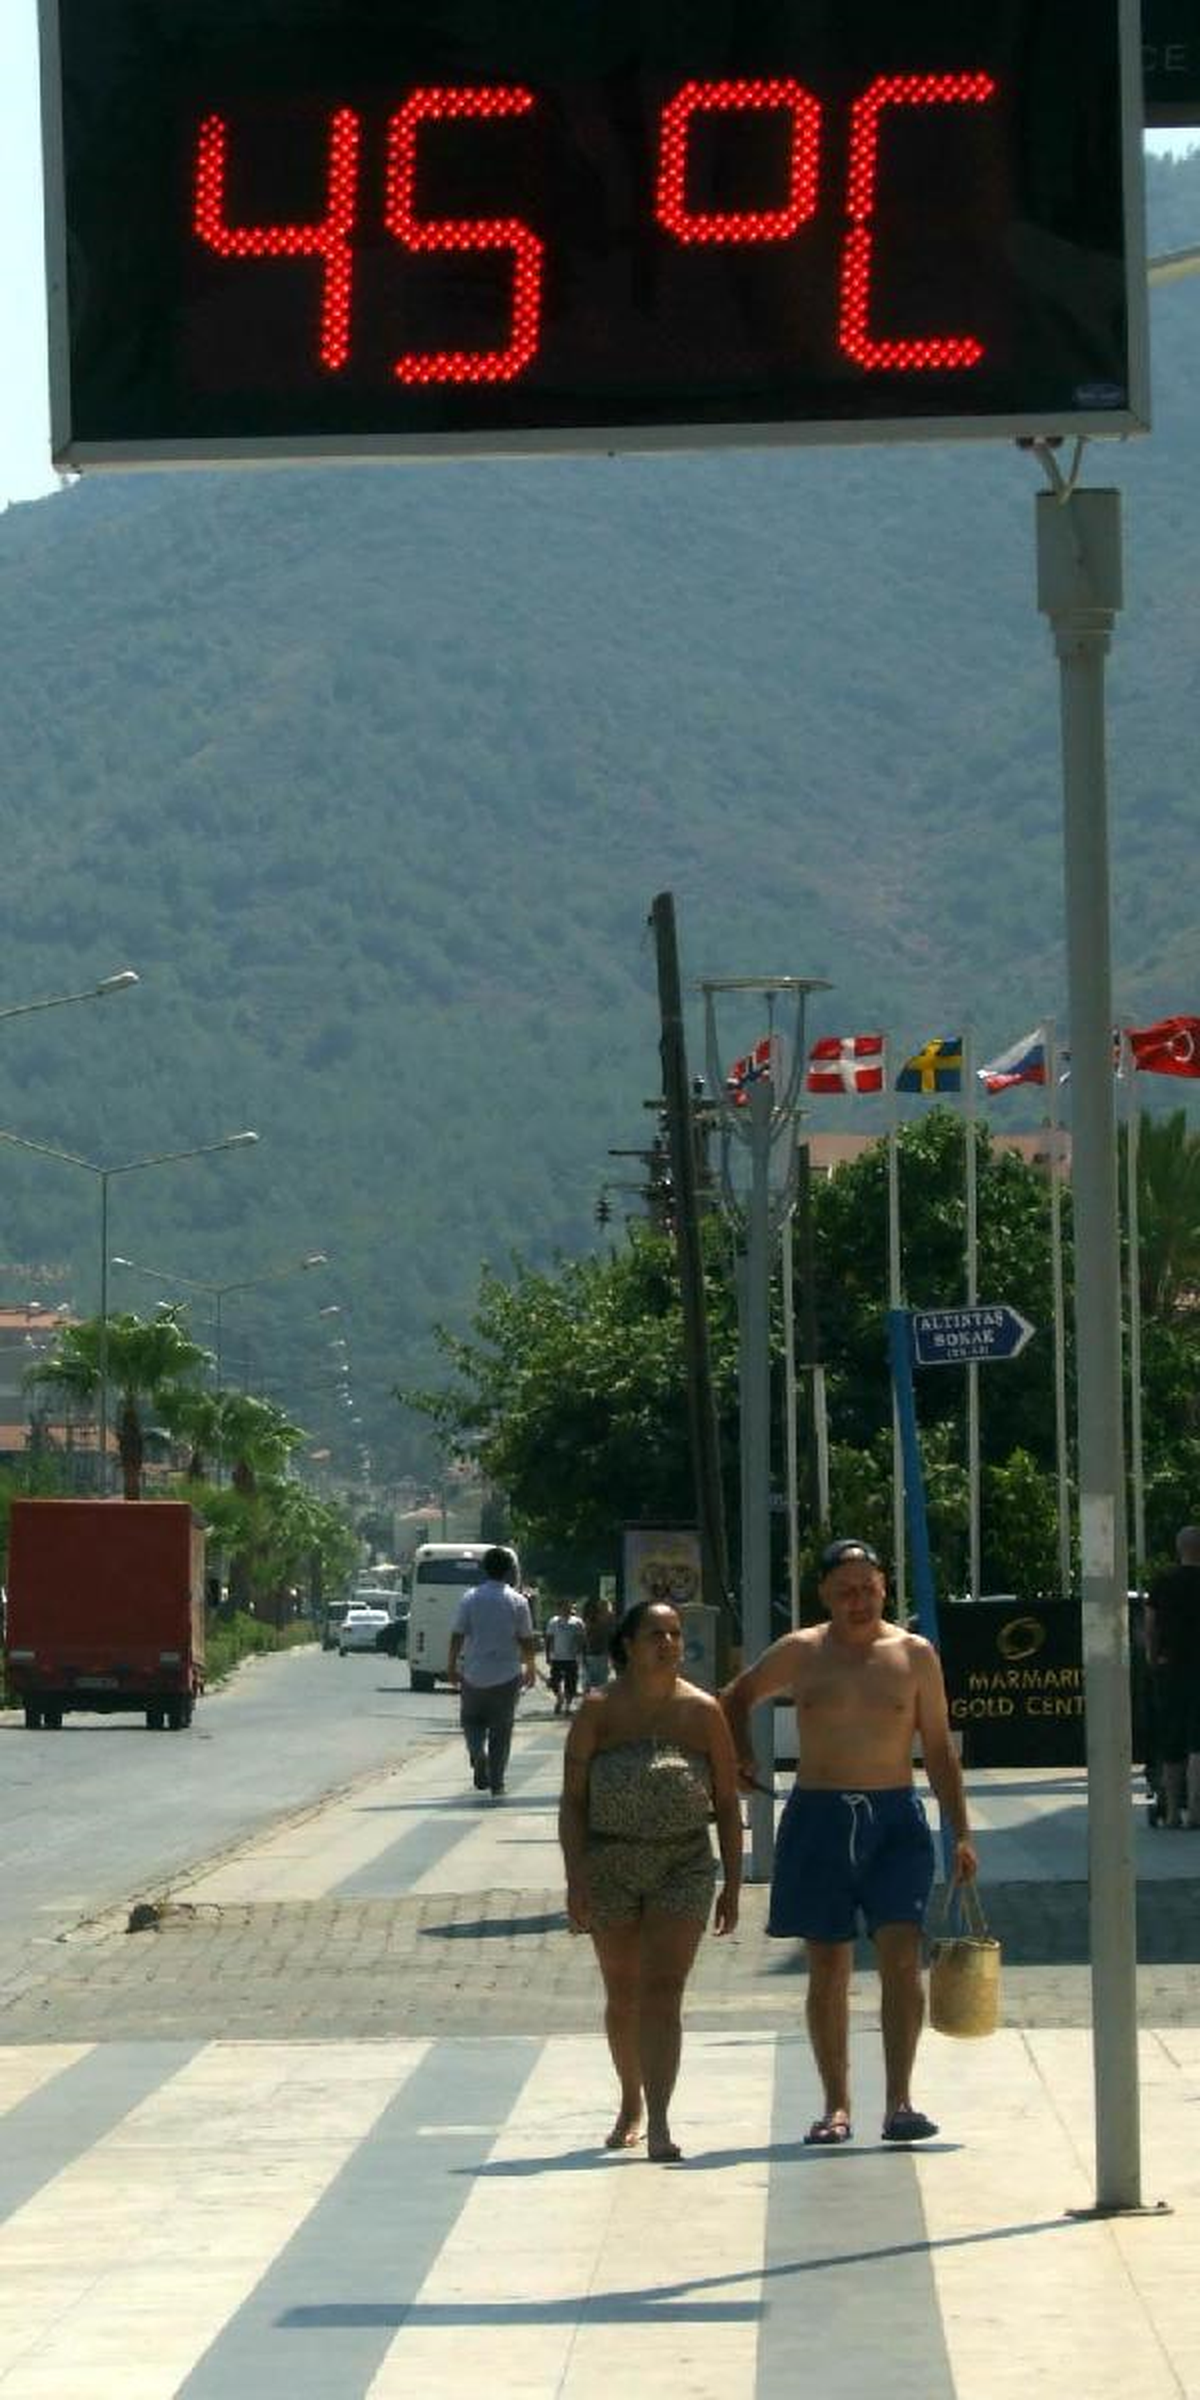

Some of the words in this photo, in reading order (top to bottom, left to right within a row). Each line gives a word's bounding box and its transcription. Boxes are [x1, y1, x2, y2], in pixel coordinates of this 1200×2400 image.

[193, 84, 544, 385] 45
[934, 1329, 994, 1347] SOKAK
[969, 1668, 1087, 1690] MARMARI
[952, 1696, 1014, 1718] GOLD
